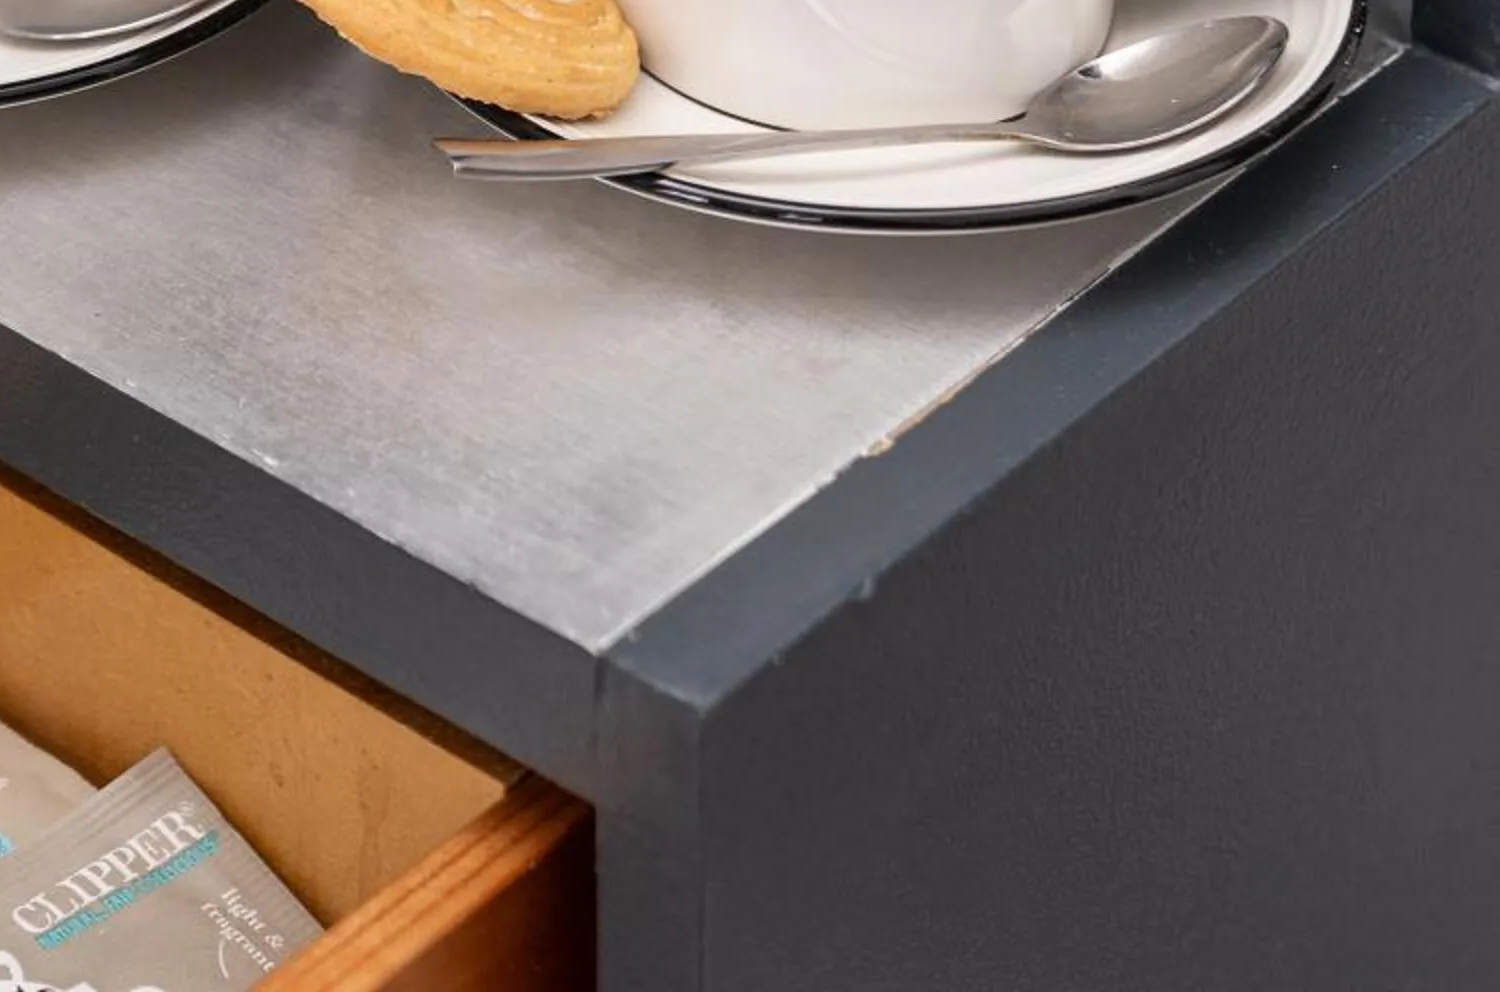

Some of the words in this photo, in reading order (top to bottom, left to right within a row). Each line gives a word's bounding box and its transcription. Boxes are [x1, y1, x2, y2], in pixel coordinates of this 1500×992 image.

[12, 810, 205, 934] CLIPPER
[200, 901, 276, 974] fragrant
[221, 887, 267, 932] light
[265, 934, 285, 950] &
